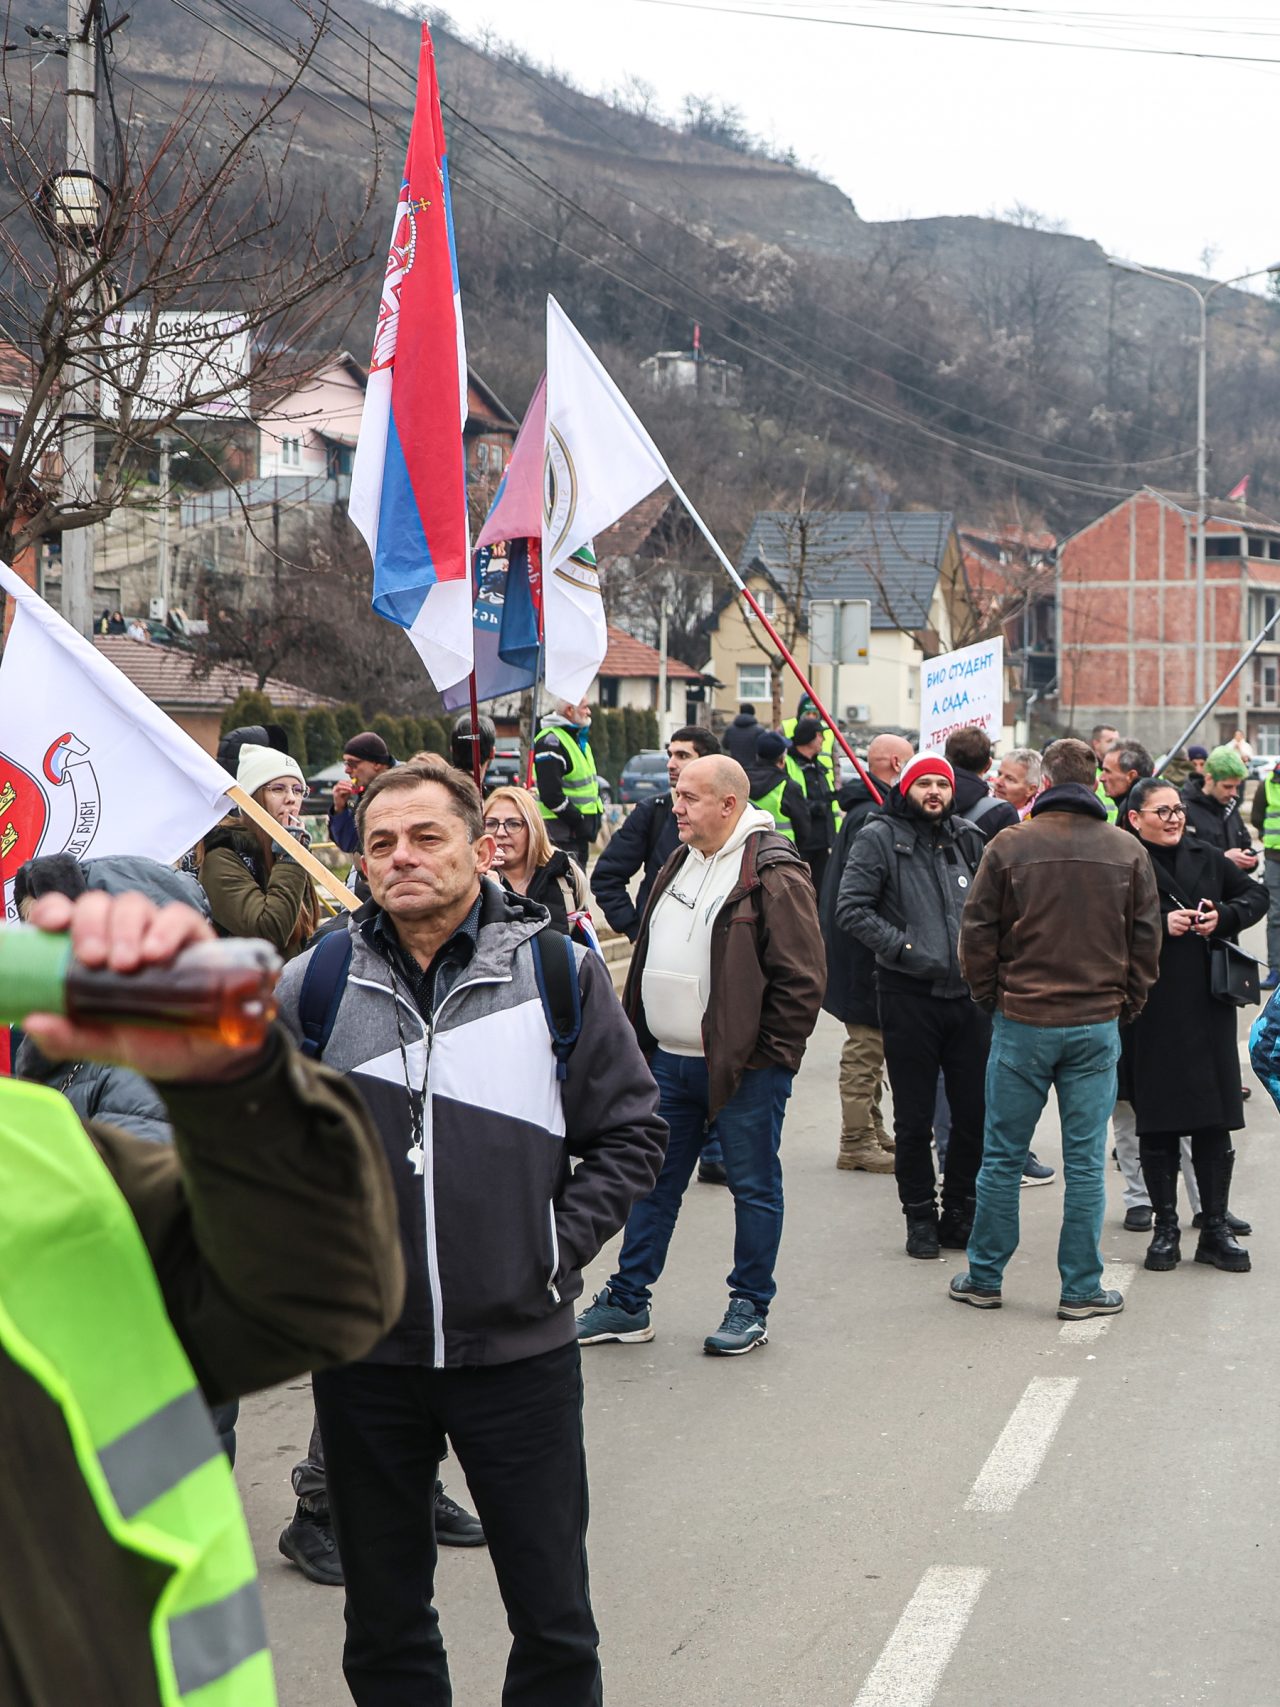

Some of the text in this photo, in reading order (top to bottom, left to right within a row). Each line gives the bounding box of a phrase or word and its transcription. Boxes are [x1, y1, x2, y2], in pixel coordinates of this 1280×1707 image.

[927, 653, 994, 688] БИО СТУДЕНТ
[932, 700, 940, 715] А
